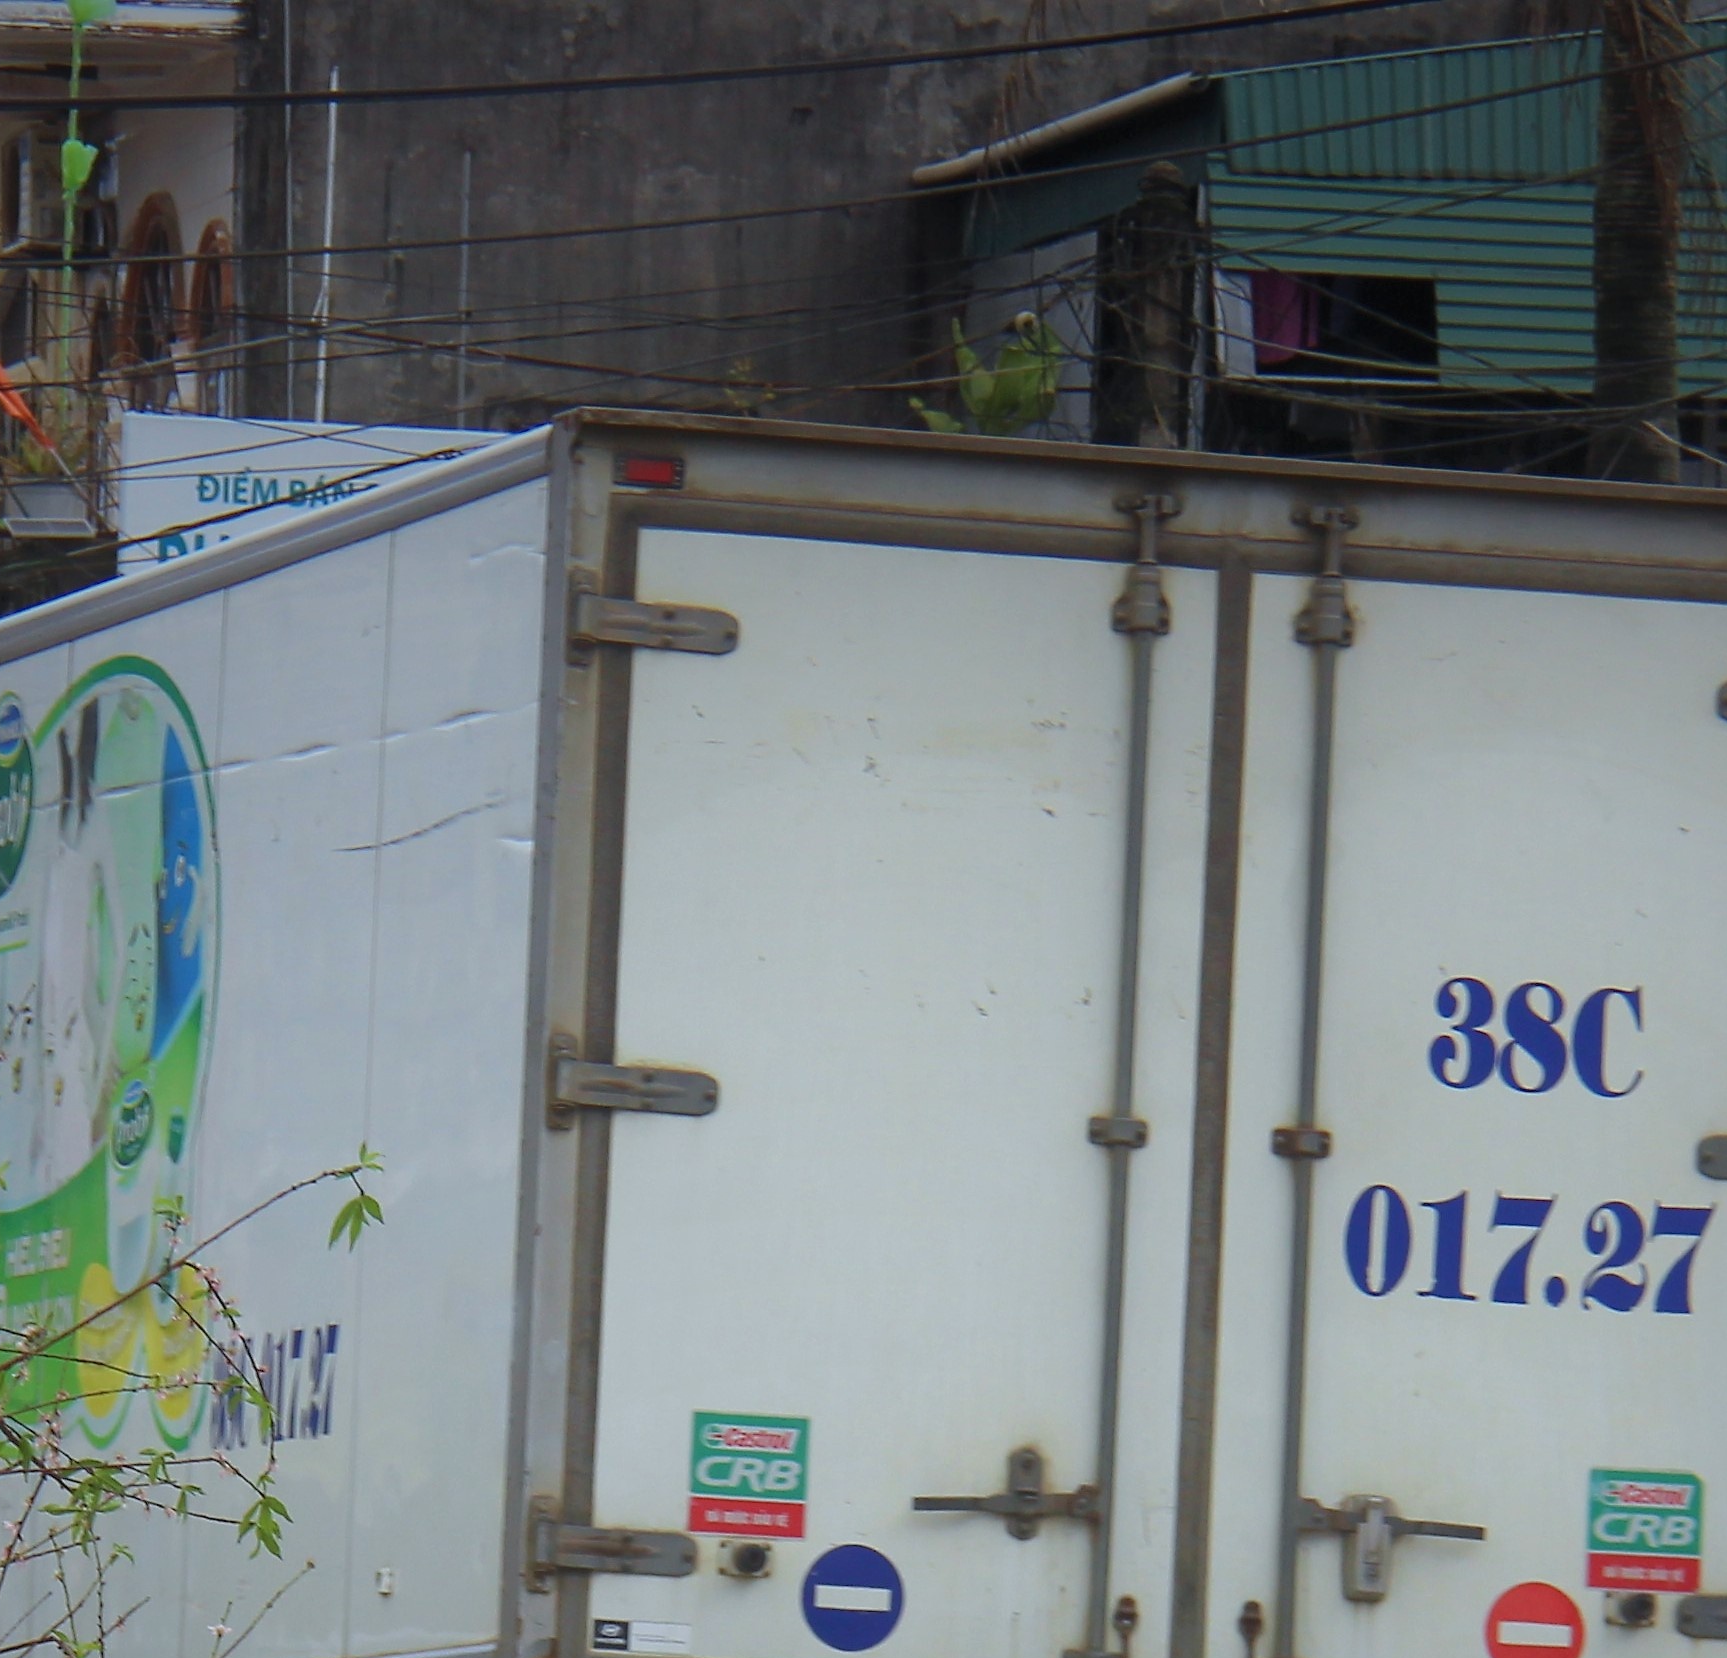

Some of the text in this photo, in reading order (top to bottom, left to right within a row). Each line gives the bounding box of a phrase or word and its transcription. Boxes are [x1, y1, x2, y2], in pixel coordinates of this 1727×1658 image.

[1427, 976, 1645, 1099] 38C
[1344, 1183, 1718, 1316] 017.27
[695, 1455, 803, 1493] CRB
[1593, 1512, 1698, 1548] CRB
